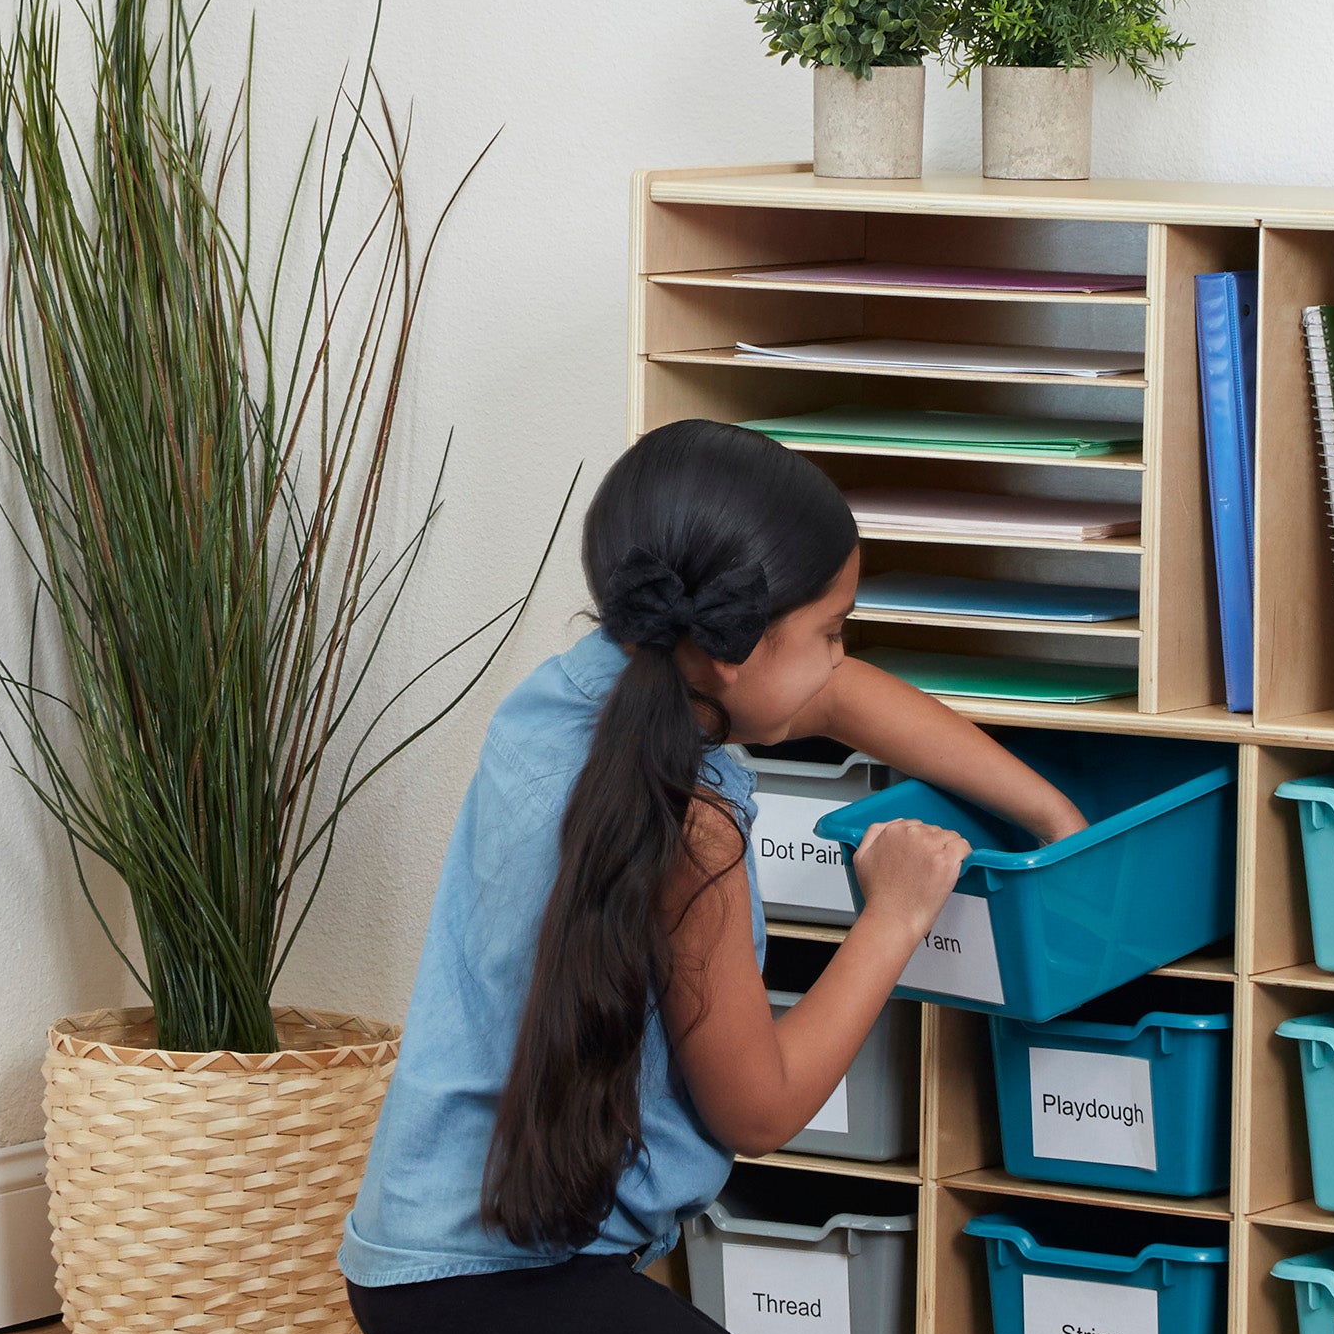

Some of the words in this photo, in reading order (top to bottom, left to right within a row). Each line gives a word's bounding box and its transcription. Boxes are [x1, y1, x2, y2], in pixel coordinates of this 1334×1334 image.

[761, 838, 794, 860] Dot
[1042, 1094, 1144, 1127] Playdough
[752, 1292, 822, 1318] Thread
